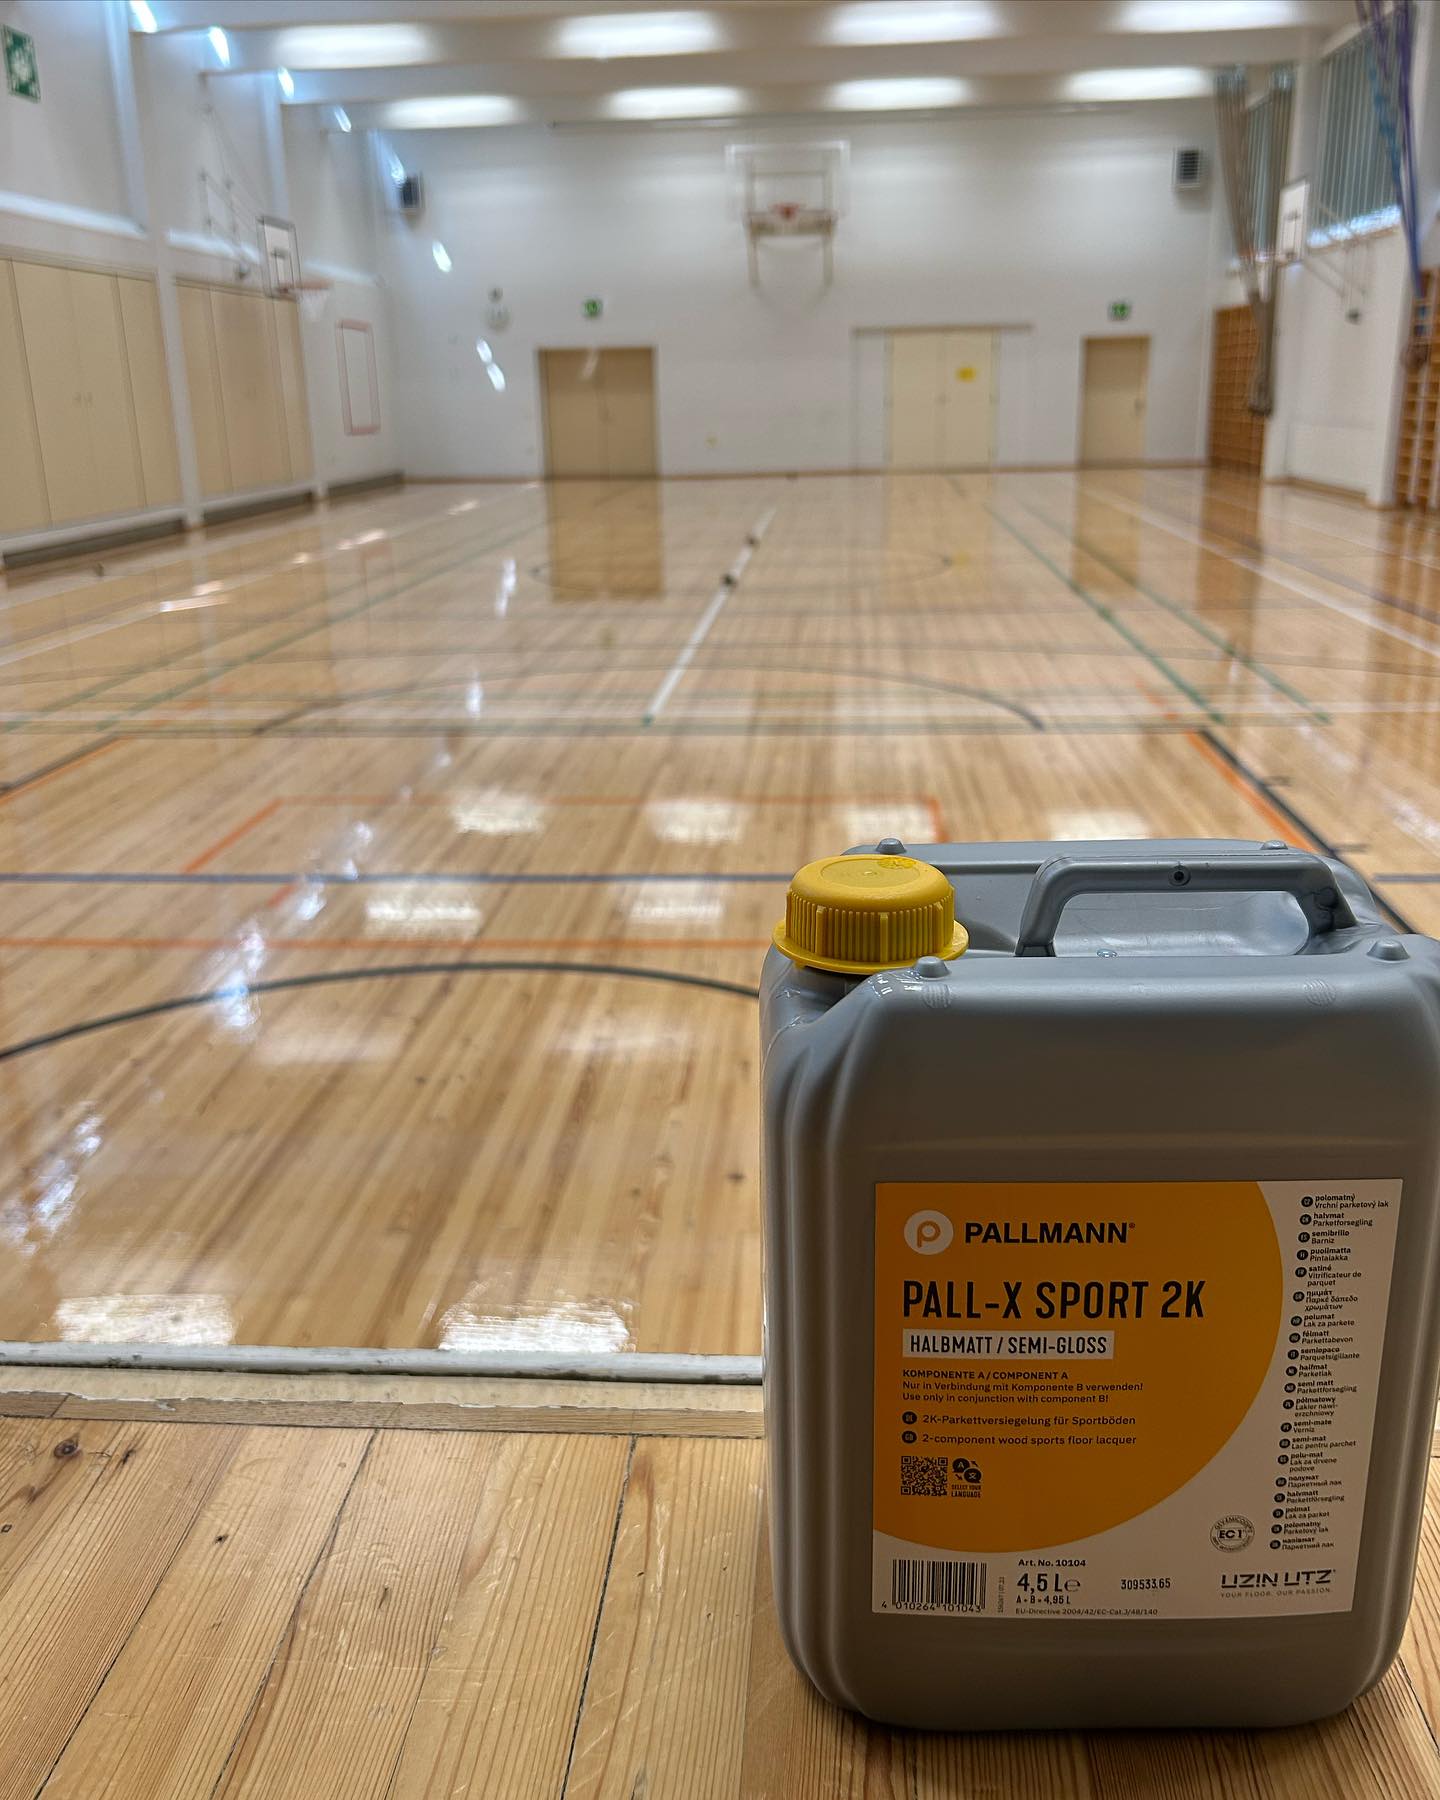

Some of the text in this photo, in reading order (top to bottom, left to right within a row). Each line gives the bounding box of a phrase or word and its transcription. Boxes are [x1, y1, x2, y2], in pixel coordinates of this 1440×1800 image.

[1313, 1219, 1373, 1227] Parketforsegling
[1310, 1247, 1351, 1255] puolimatta
[1310, 1254, 1348, 1262] Pintalakka
[1307, 1279, 1336, 1287] parquet
[903, 1280, 1206, 1319] PALL-X SPORT 2K
[1327, 1320, 1355, 1328] parkete
[910, 1335, 993, 1354] HALBMATT
[1008, 1336, 1107, 1354] SEMI-GLOSS
[903, 1370, 975, 1379] KOMPONENTE
[903, 1381, 1143, 1393] Nur in Verbindung mit Komponente B verwenden!
[903, 1393, 1109, 1404] Use only in conjunction with component B!
[922, 1414, 1051, 1426] 2K-Parkettversiegelung
[1054, 1415, 1069, 1425] für
[1072, 1415, 1135, 1426] Sportböden
[922, 1434, 995, 1446] 2-component
[998, 1435, 1028, 1445] wood
[1031, 1435, 1065, 1446] sports
[1068, 1435, 1093, 1445] floor
[1096, 1435, 1136, 1446] lacquer
[1038, 1559, 1053, 1567] No.
[1017, 1573, 1048, 1594] 4,5
[1016, 1596, 1021, 1604] A
[1030, 1596, 1035, 1604] B
[882, 1601, 982, 1613] 4 010264 101043
